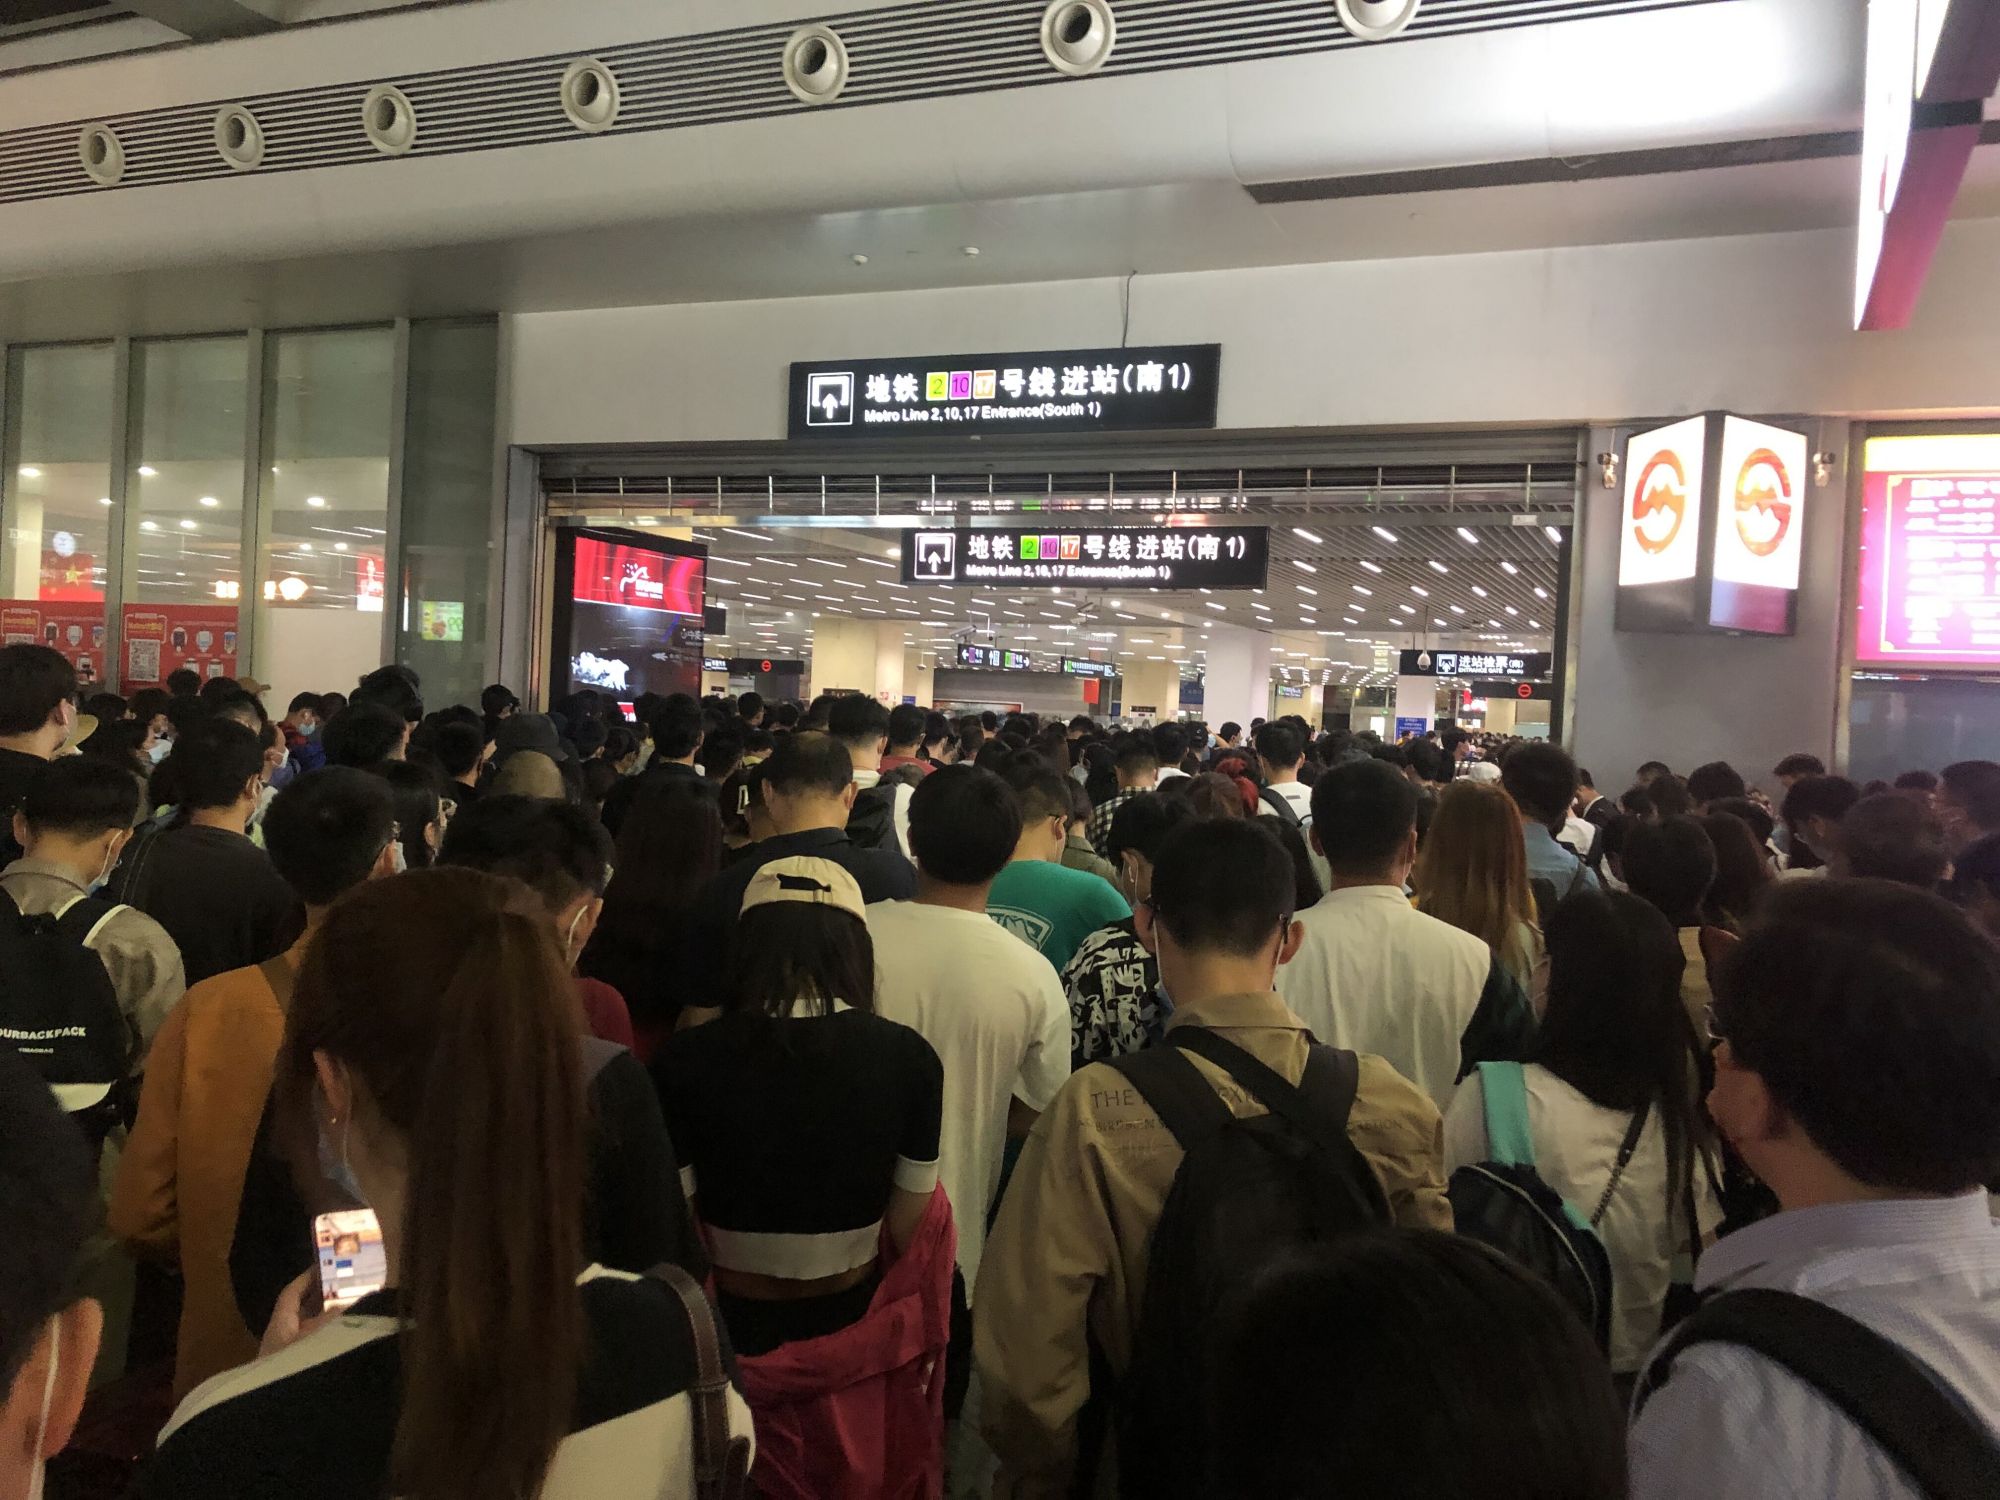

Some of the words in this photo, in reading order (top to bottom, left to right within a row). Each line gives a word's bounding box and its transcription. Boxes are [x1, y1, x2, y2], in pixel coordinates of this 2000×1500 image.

[865, 373, 919, 403] 地铁
[864, 408, 900, 422] Metro
[902, 408, 930, 422] Line
[968, 535, 1014, 560] 地铁
[965, 564, 998, 577] Metro
[998, 564, 1023, 577] Line
[1090, 1088, 1136, 1108] THE
